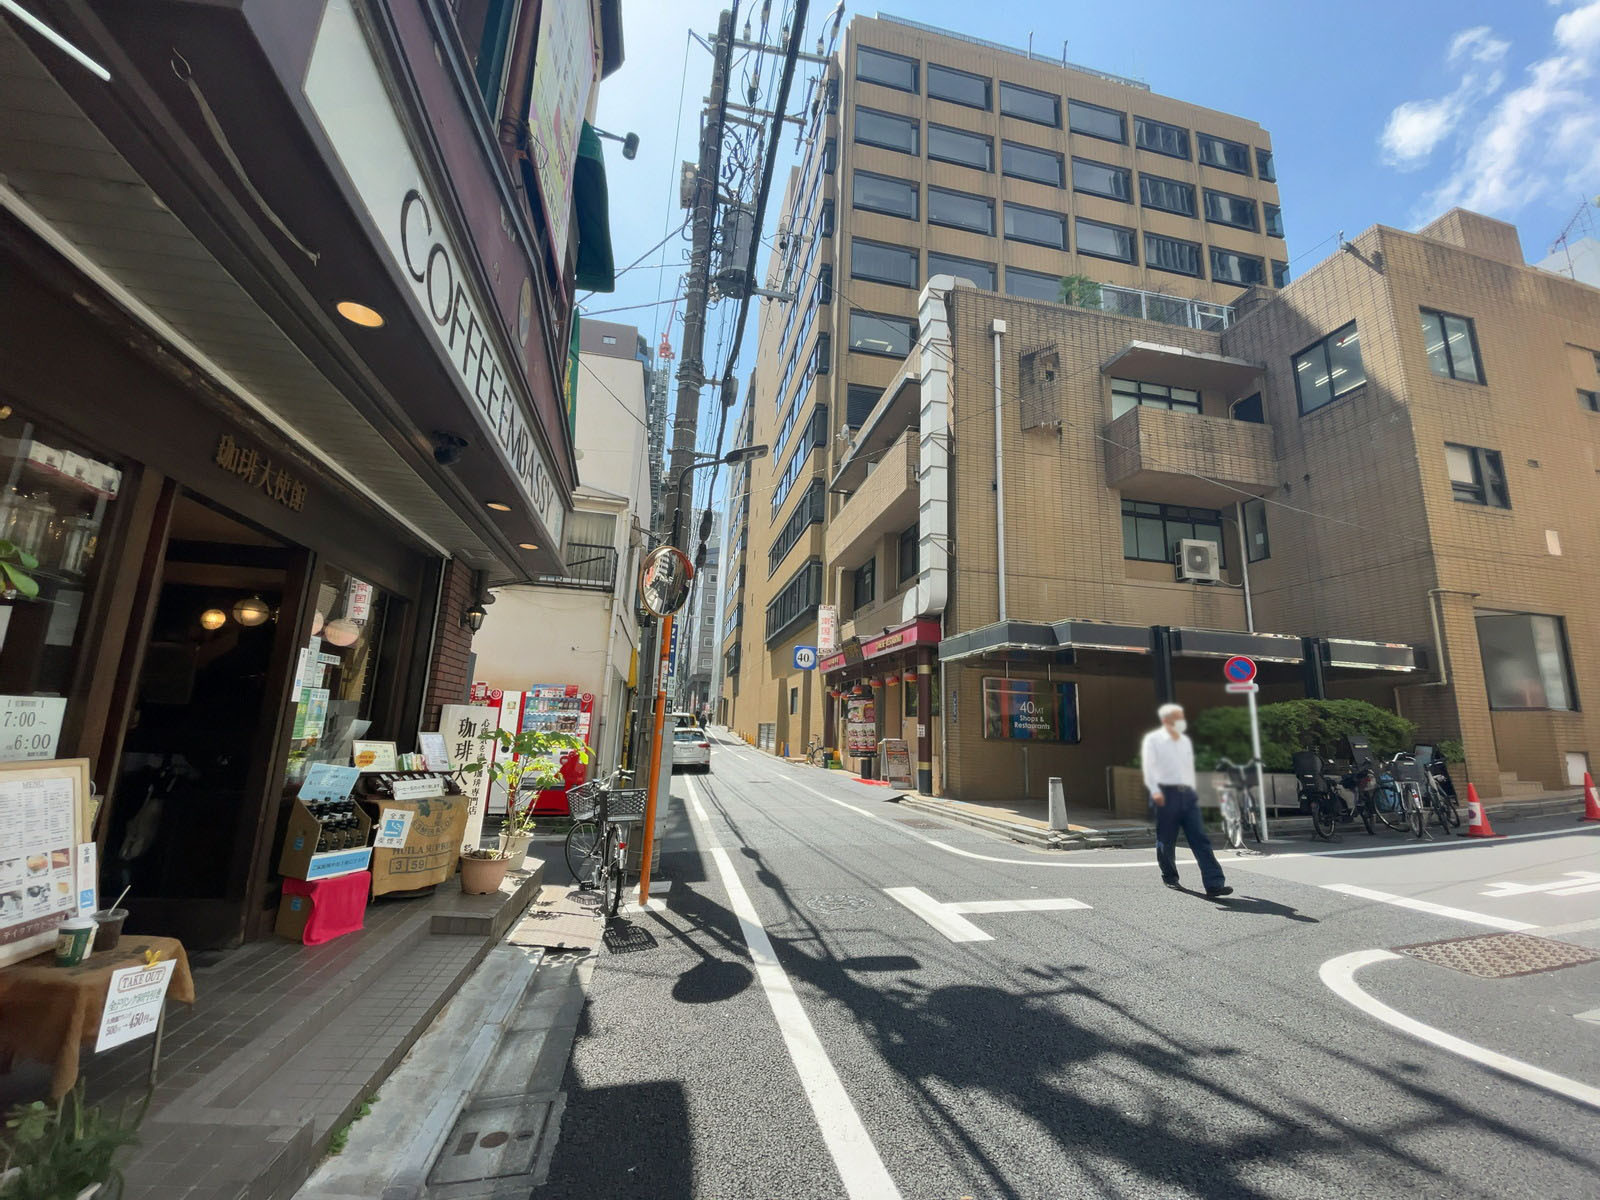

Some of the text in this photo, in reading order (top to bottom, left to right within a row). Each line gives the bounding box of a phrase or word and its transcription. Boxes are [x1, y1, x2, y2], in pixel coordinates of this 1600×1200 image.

[400, 188, 554, 524] COFFEE EMBASSY
[216, 434, 307, 512] 珈琲大使館
[797, 652, 810, 663] 40
[1014, 721, 1050, 730] Restaurants
[1019, 714, 1038, 723] Shops
[14, 733, 52, 751] 6:00
[395, 859, 425, 871] 3 59
[122, 969, 164, 988] TAKE OUT
